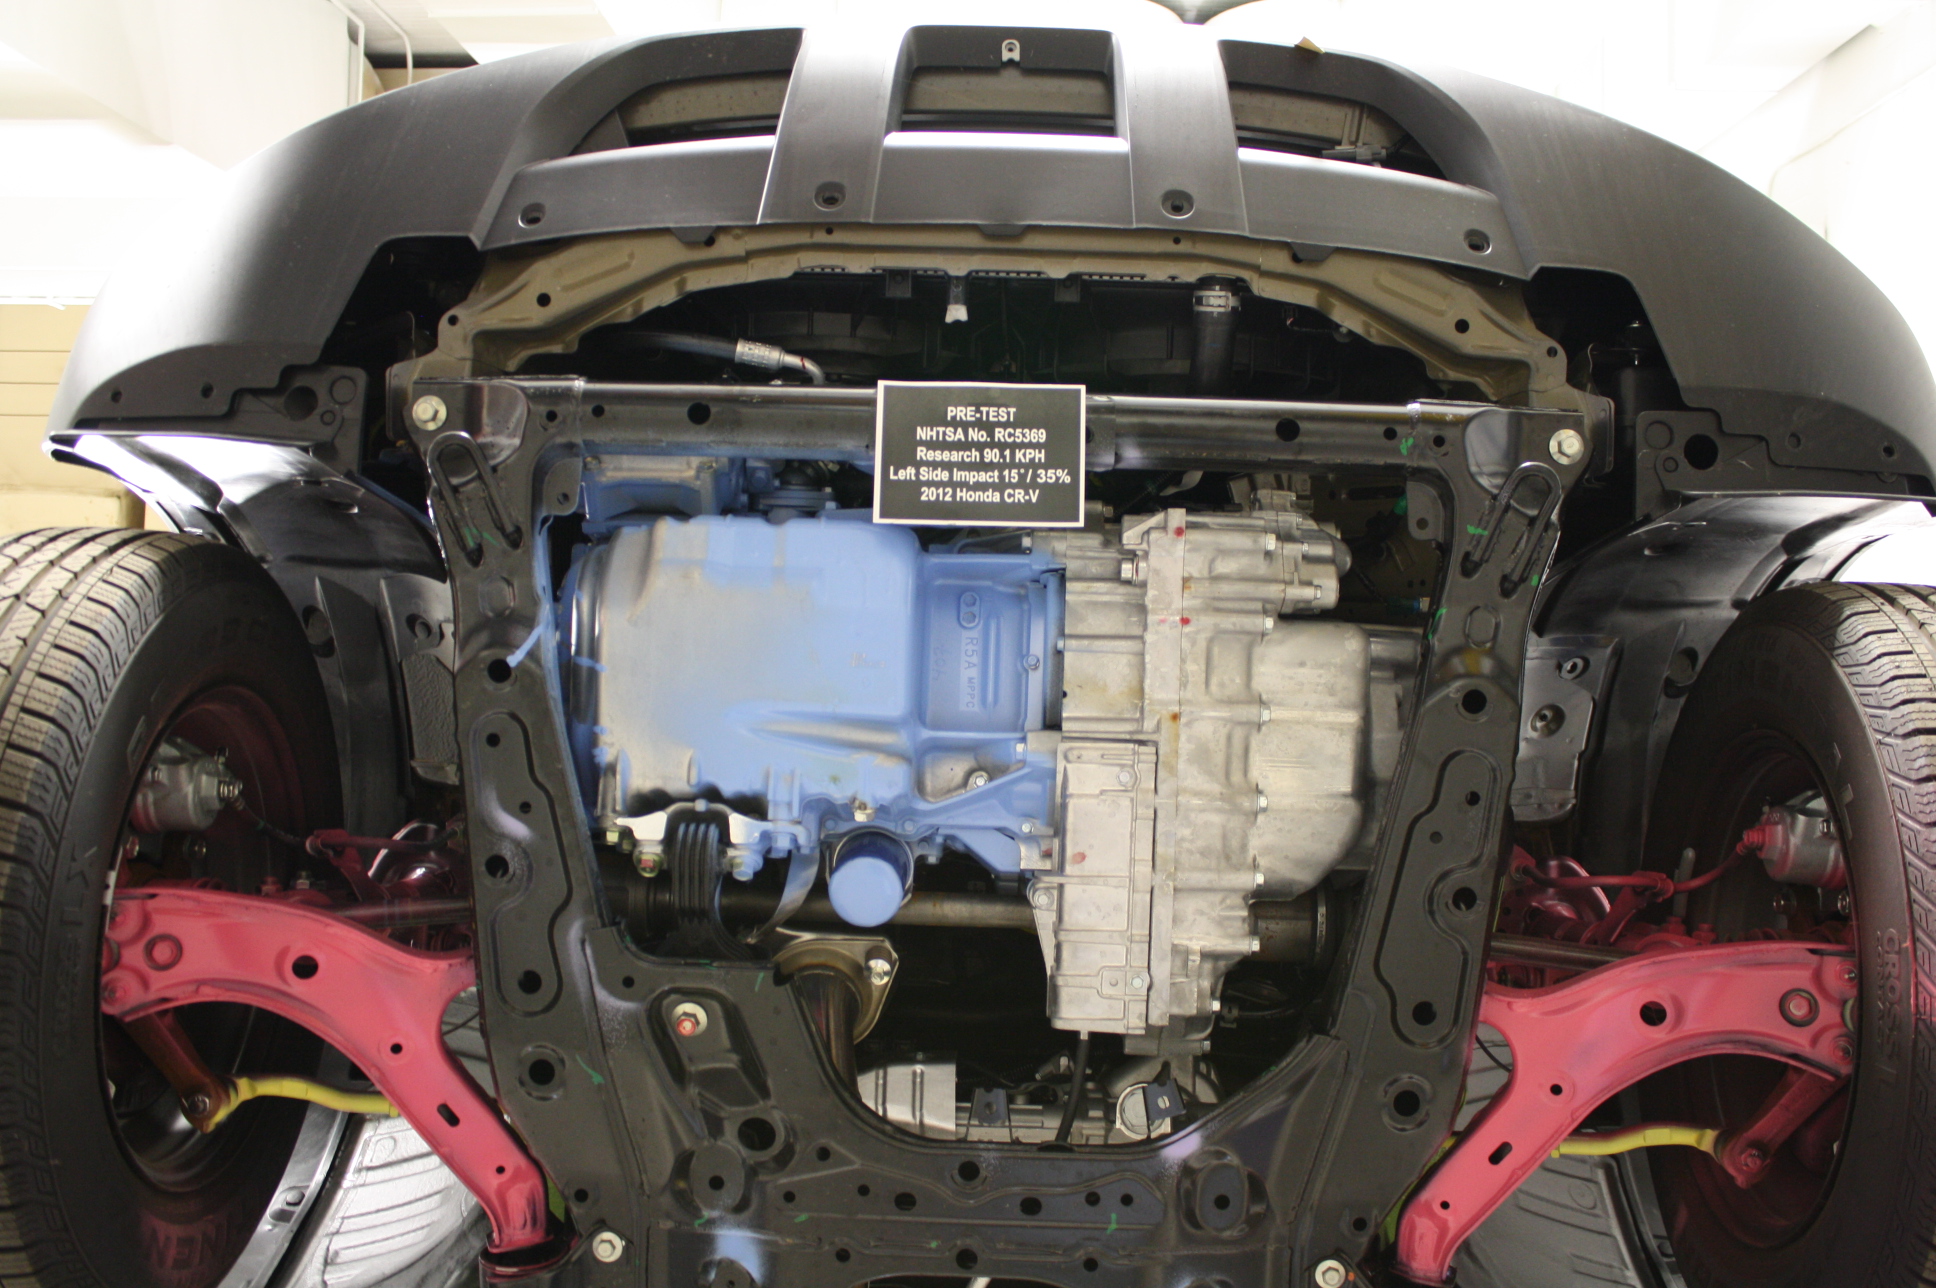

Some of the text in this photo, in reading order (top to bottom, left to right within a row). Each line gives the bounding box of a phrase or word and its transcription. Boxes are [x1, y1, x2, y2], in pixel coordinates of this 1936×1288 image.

[947, 406, 1016, 422] PRE-TEST
[916, 426, 1046, 443] NHTSA No. RC5369
[916, 446, 1045, 463] Research 90.1 KPH
[889, 466, 916, 480] Left
[919, 467, 949, 481] Side
[953, 468, 999, 485] Impact
[1036, 469, 1071, 484] 35%
[920, 487, 1039, 503] 2012 Honda CR-V
[964, 636, 978, 670] R5A
[1882, 928, 1901, 1060] CROSS
